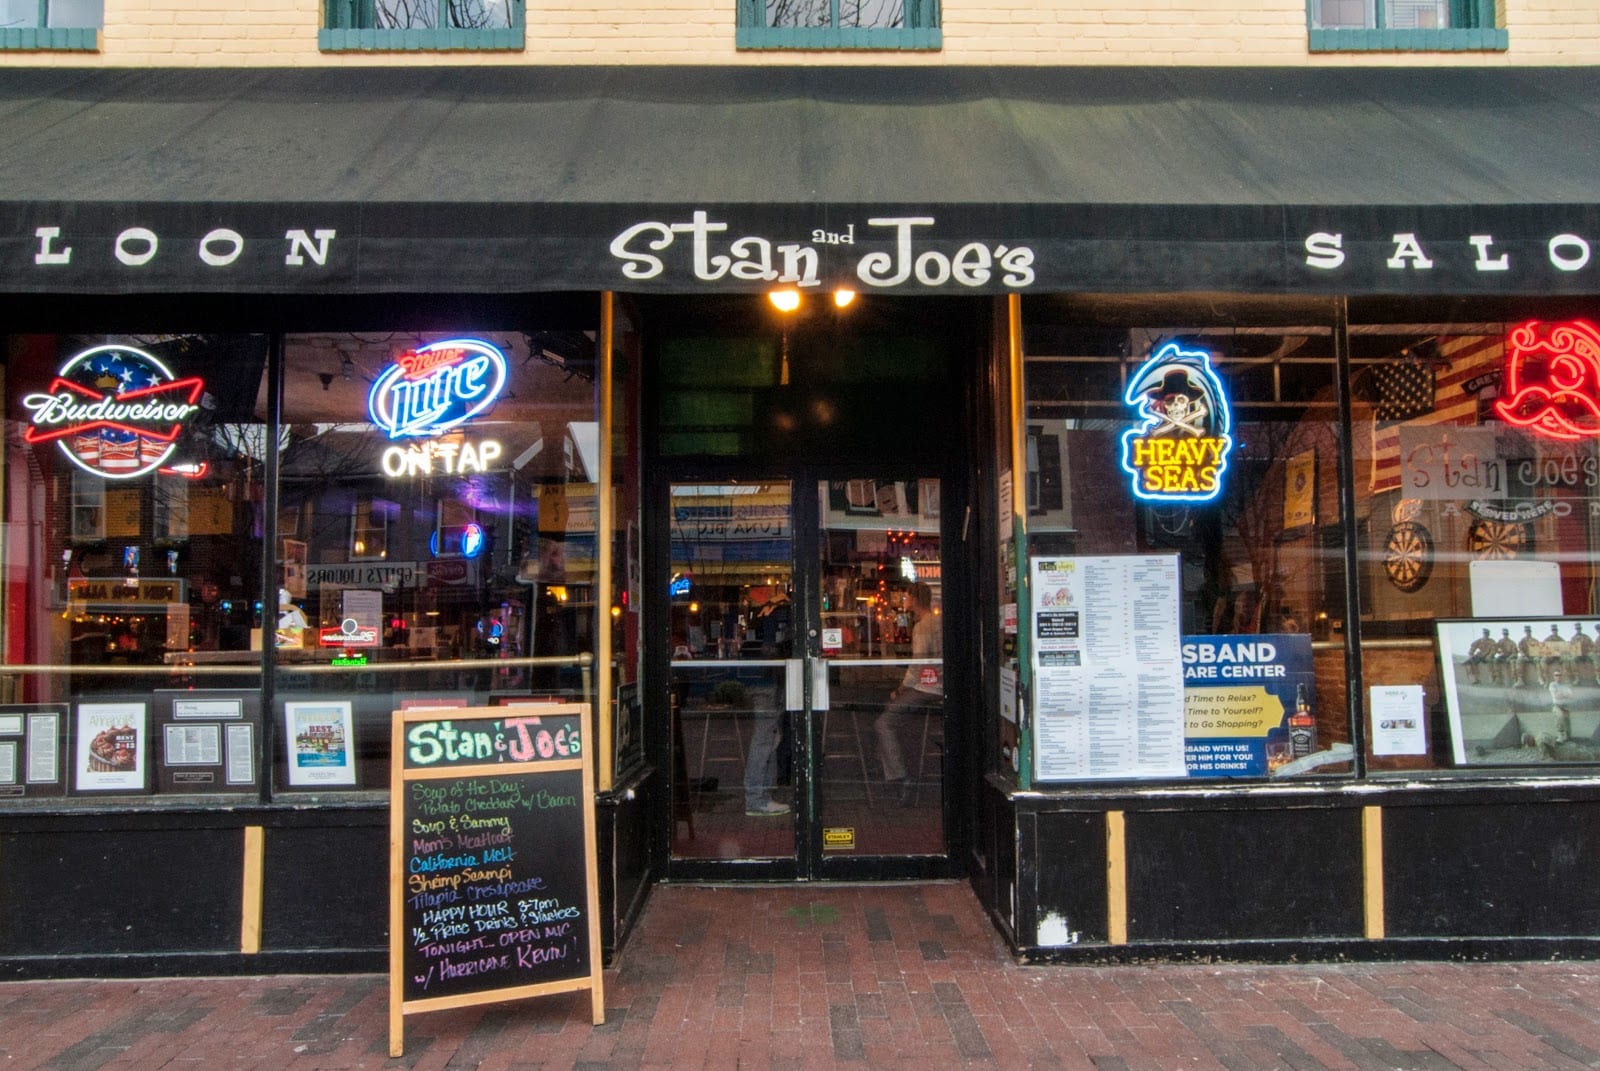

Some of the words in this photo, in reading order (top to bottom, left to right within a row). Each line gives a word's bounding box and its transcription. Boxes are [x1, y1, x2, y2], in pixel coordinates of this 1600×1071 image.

[609, 210, 821, 286] Stan
[811, 224, 854, 245] and
[857, 216, 1036, 287] Joe's
[399, 349, 464, 377] Miller
[23, 393, 198, 424] Budweiser
[390, 356, 489, 438] Lite
[382, 443, 432, 477] ON
[439, 440, 501, 473] TAP
[1133, 438, 1226, 465] HEAVY
[1407, 433, 1501, 491] Stan
[1518, 446, 1597, 487] Joe's
[1144, 466, 1217, 491] SEAS
[1182, 666, 1218, 678] ARE
[1221, 664, 1286, 678] CENTER
[1188, 708, 1208, 716] Time
[1211, 707, 1220, 716] to
[1222, 706, 1264, 716] Yourself?
[1193, 695, 1214, 703] Time
[1216, 694, 1225, 703] to
[1227, 694, 1257, 703] Relax?
[1190, 721, 1199, 729] to
[1201, 720, 1214, 729] Go
[1216, 719, 1264, 729] Shopping?
[408, 721, 492, 764] Stan
[505, 716, 581, 762] Joe's
[1212, 744, 1234, 752] WITH
[1235, 744, 1249, 752] US!
[1214, 753, 1231, 761] FOR
[1232, 753, 1253, 761] YOU!
[1214, 762, 1248, 770] DRINKS!
[412, 782, 447, 803] Soup
[450, 780, 464, 797] of
[466, 780, 489, 796] the
[465, 797, 515, 812] Cheddar
[537, 789, 577, 809] Bacon
[412, 818, 445, 835] Soup
[449, 815, 459, 833] &
[460, 814, 510, 836] Sammy
[413, 834, 453, 855] Mom's
[457, 831, 516, 849] Meatloaf
[410, 853, 480, 873] California
[408, 874, 461, 893] Shrimp
[462, 864, 512, 883] Scampi
[408, 888, 463, 909] Tilapia
[467, 877, 549, 899] Chesapeake
[423, 905, 466, 925] HAPPY
[469, 901, 509, 919] HOUR
[518, 898, 559, 913] 3-7pm
[499, 928, 541, 947] OPEN
[545, 922, 570, 938] MIC
[440, 955, 511, 981] HURRICANE
